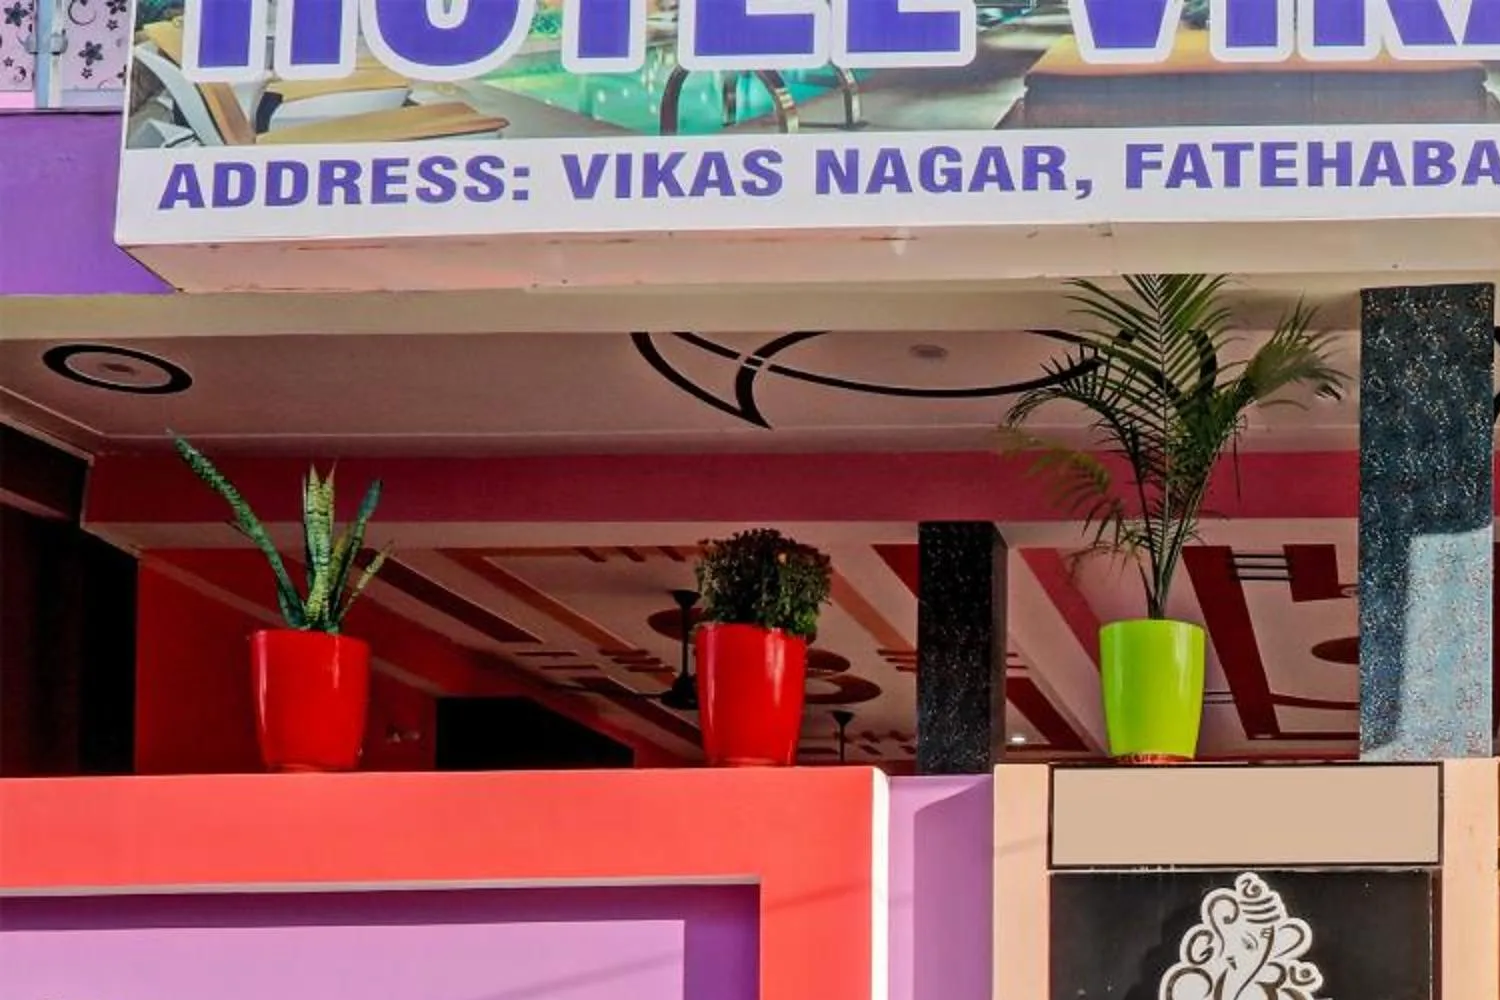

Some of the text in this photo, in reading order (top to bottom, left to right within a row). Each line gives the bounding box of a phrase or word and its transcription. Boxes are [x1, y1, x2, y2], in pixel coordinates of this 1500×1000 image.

[158, 154, 530, 209] ADDRESS:
[561, 151, 783, 199] VIKAS
[815, 145, 1092, 202] NAGAR,
